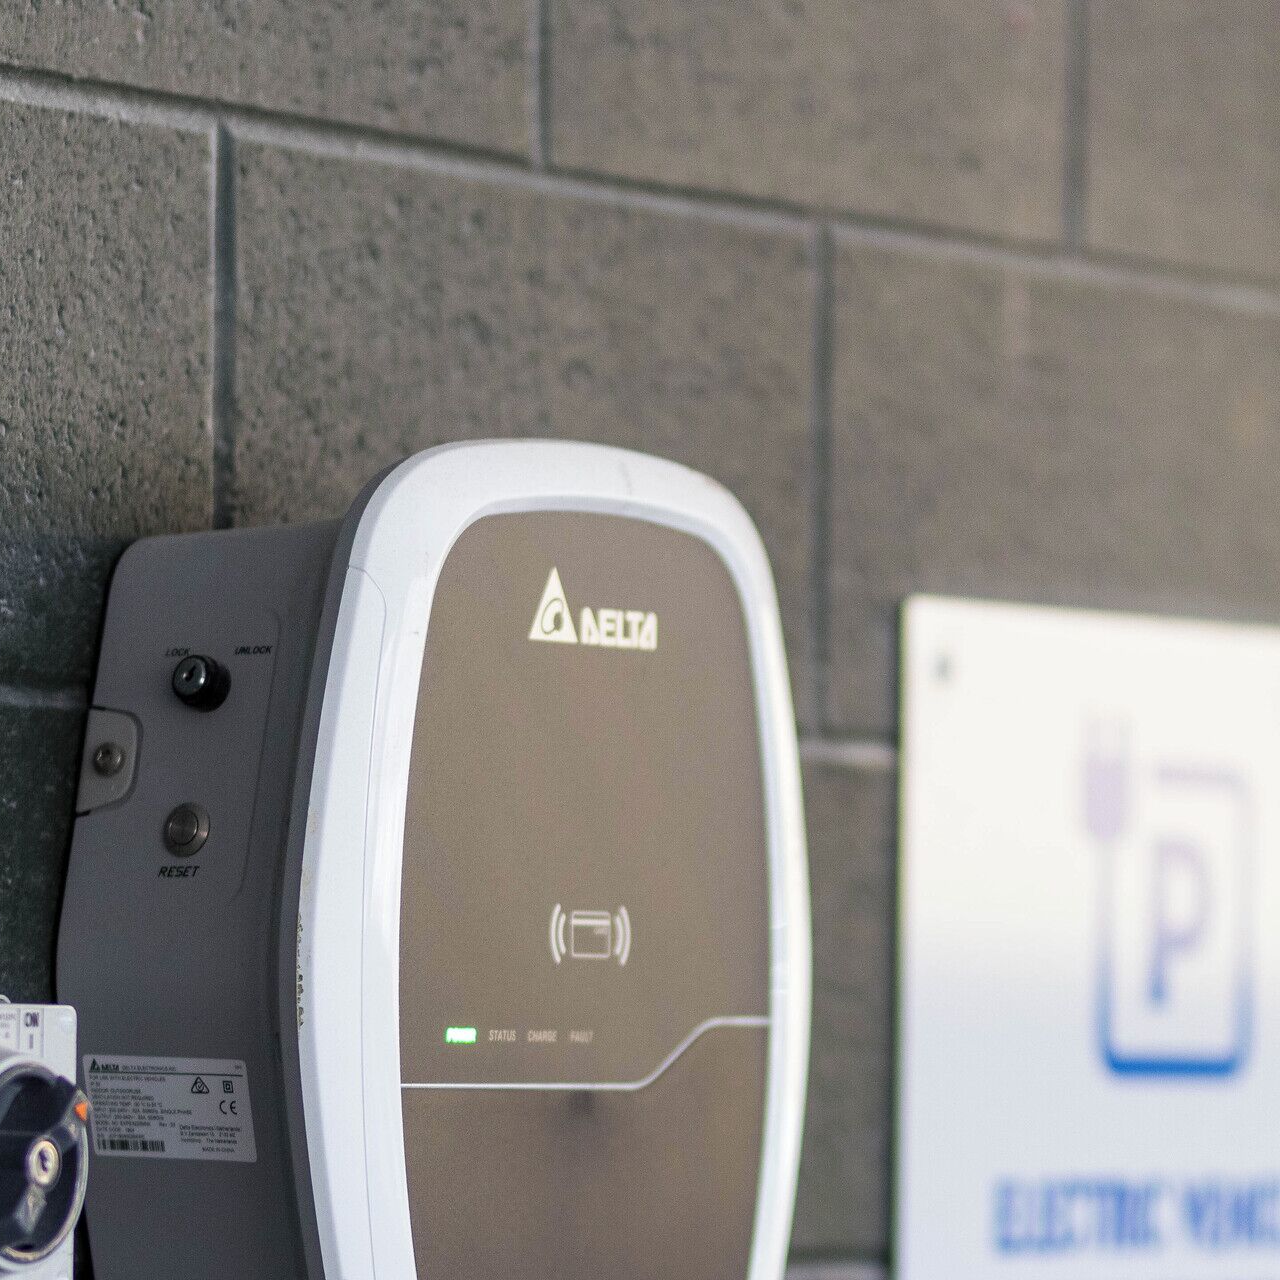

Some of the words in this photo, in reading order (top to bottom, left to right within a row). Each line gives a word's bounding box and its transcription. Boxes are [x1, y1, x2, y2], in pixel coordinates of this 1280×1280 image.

[580, 606, 658, 650] DELTA
[166, 648, 191, 657] LOCK
[234, 645, 273, 656] UNLOCK
[158, 865, 200, 878] RESET
[24, 1012, 40, 1028] ON
[488, 1029, 517, 1042] STATUS
[527, 1030, 558, 1042] CHARGE
